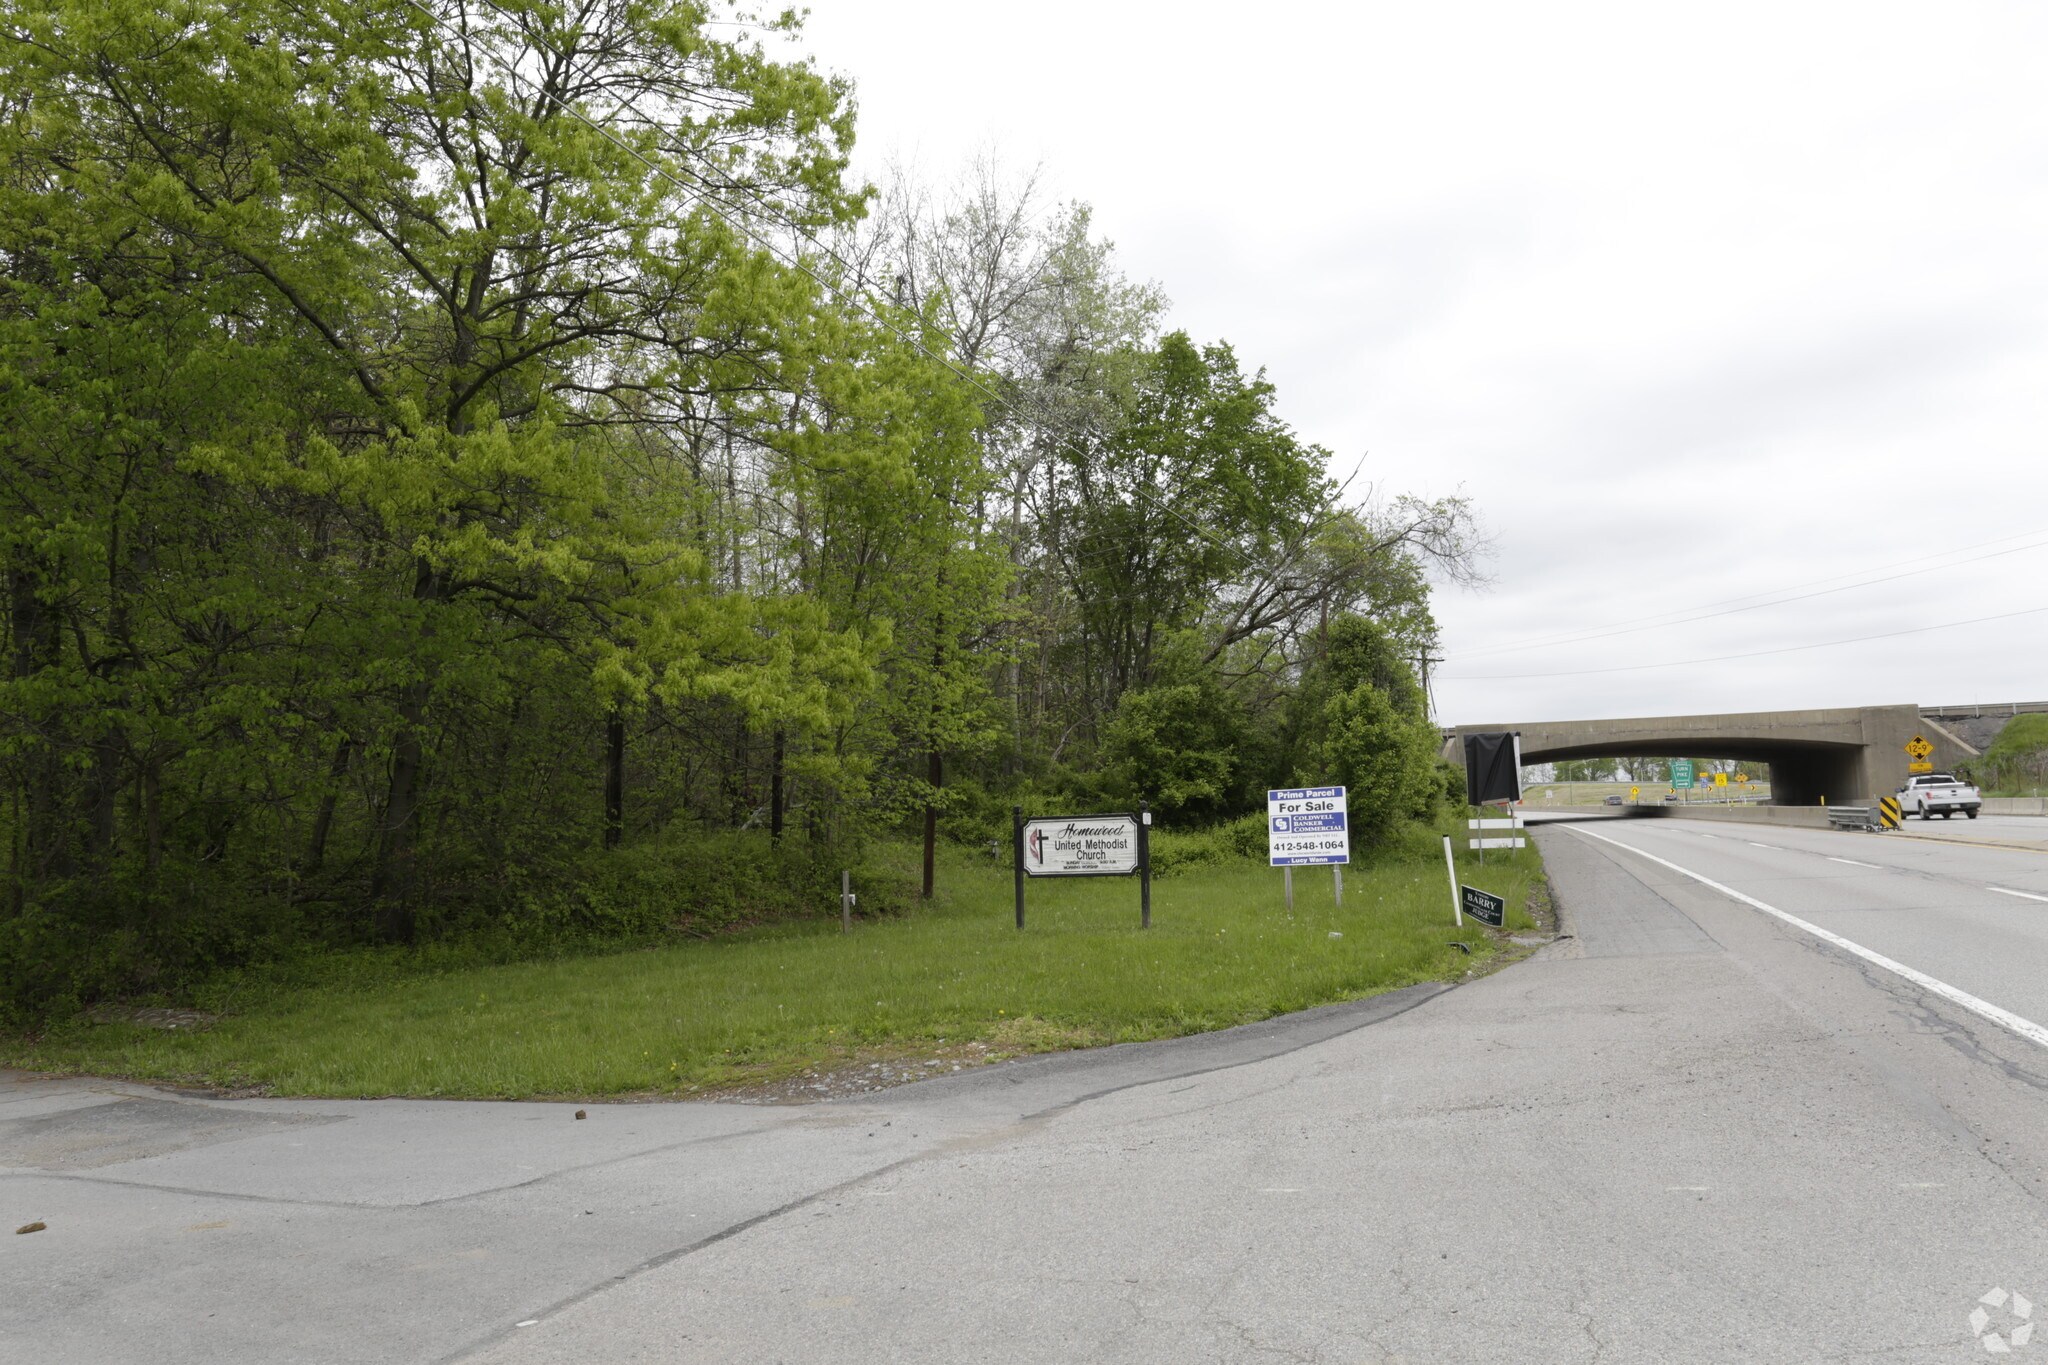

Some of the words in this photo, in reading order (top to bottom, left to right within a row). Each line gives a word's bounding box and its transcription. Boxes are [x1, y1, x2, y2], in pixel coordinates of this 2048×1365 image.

[1306, 789, 1335, 797] Parcel
[1279, 803, 1301, 812] For
[1305, 801, 1334, 811] Sale
[1058, 823, 1124, 839] Homewood
[1055, 840, 1081, 851] United
[1085, 839, 1128, 849] Methodist
[1274, 841, 1344, 851] 412-548-1064
[1076, 850, 1106, 860] Church
[1467, 893, 1496, 910] BARRY
